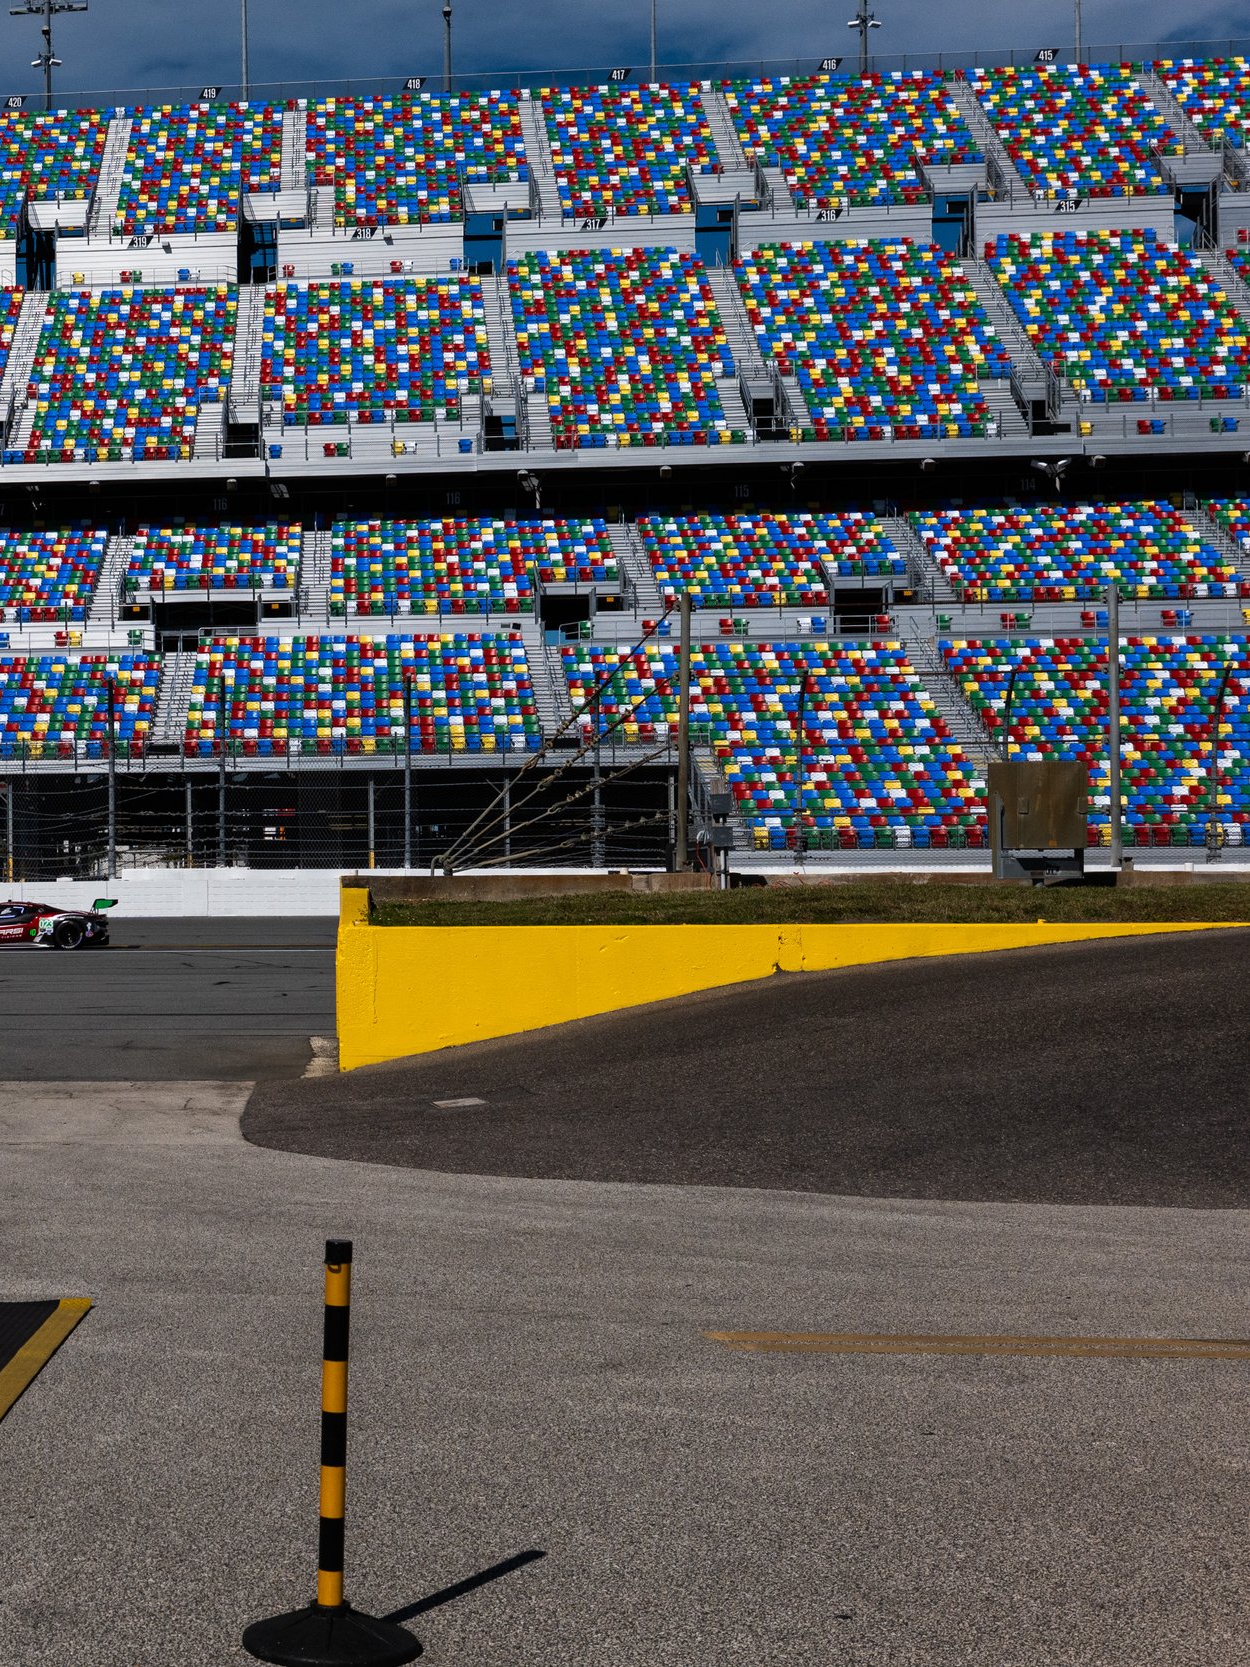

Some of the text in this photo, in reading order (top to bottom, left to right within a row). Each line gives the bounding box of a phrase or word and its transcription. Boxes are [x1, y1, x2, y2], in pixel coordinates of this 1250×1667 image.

[1039, 50, 1053, 60] 415
[822, 60, 836, 70] 416
[612, 70, 625, 80] 417
[407, 79, 420, 89] 418
[203, 88, 216, 98] 419
[8, 98, 22, 107] 420
[1060, 201, 1075, 212] 315
[821, 210, 835, 221] 316
[586, 219, 600, 229] 317
[357, 228, 371, 239] 318
[133, 237, 147, 247] 319
[734, 485, 750, 497] 115
[446, 491, 461, 504] 116
[213, 498, 227, 510] 116
[39, 918, 53, 929] 023
